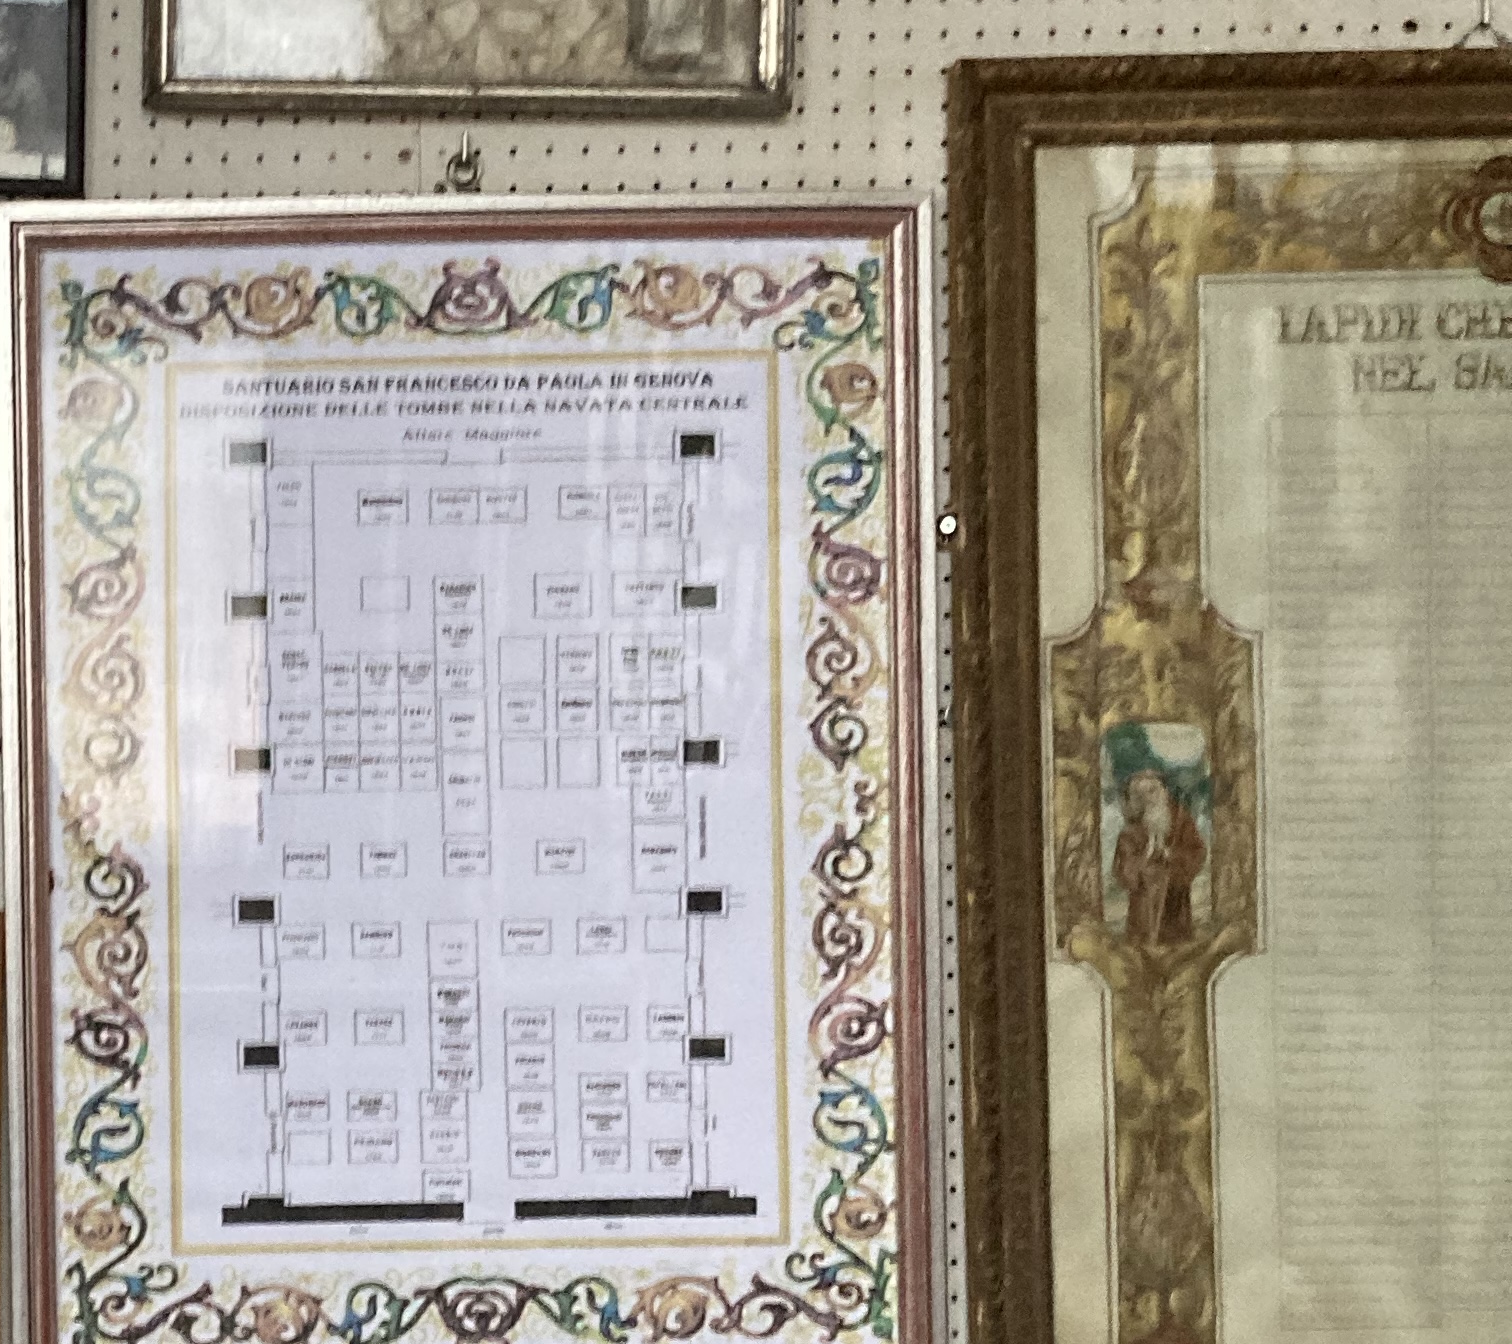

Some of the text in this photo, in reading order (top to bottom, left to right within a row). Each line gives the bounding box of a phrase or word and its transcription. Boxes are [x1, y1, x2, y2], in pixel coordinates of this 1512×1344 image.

[222, 374, 335, 397] SANTUARIO
[338, 373, 380, 396] SAN
[384, 372, 499, 395] FRANCESCO
[503, 372, 531, 391] DA
[536, 370, 602, 391] PAOLA
[633, 367, 714, 390] GENOVA
